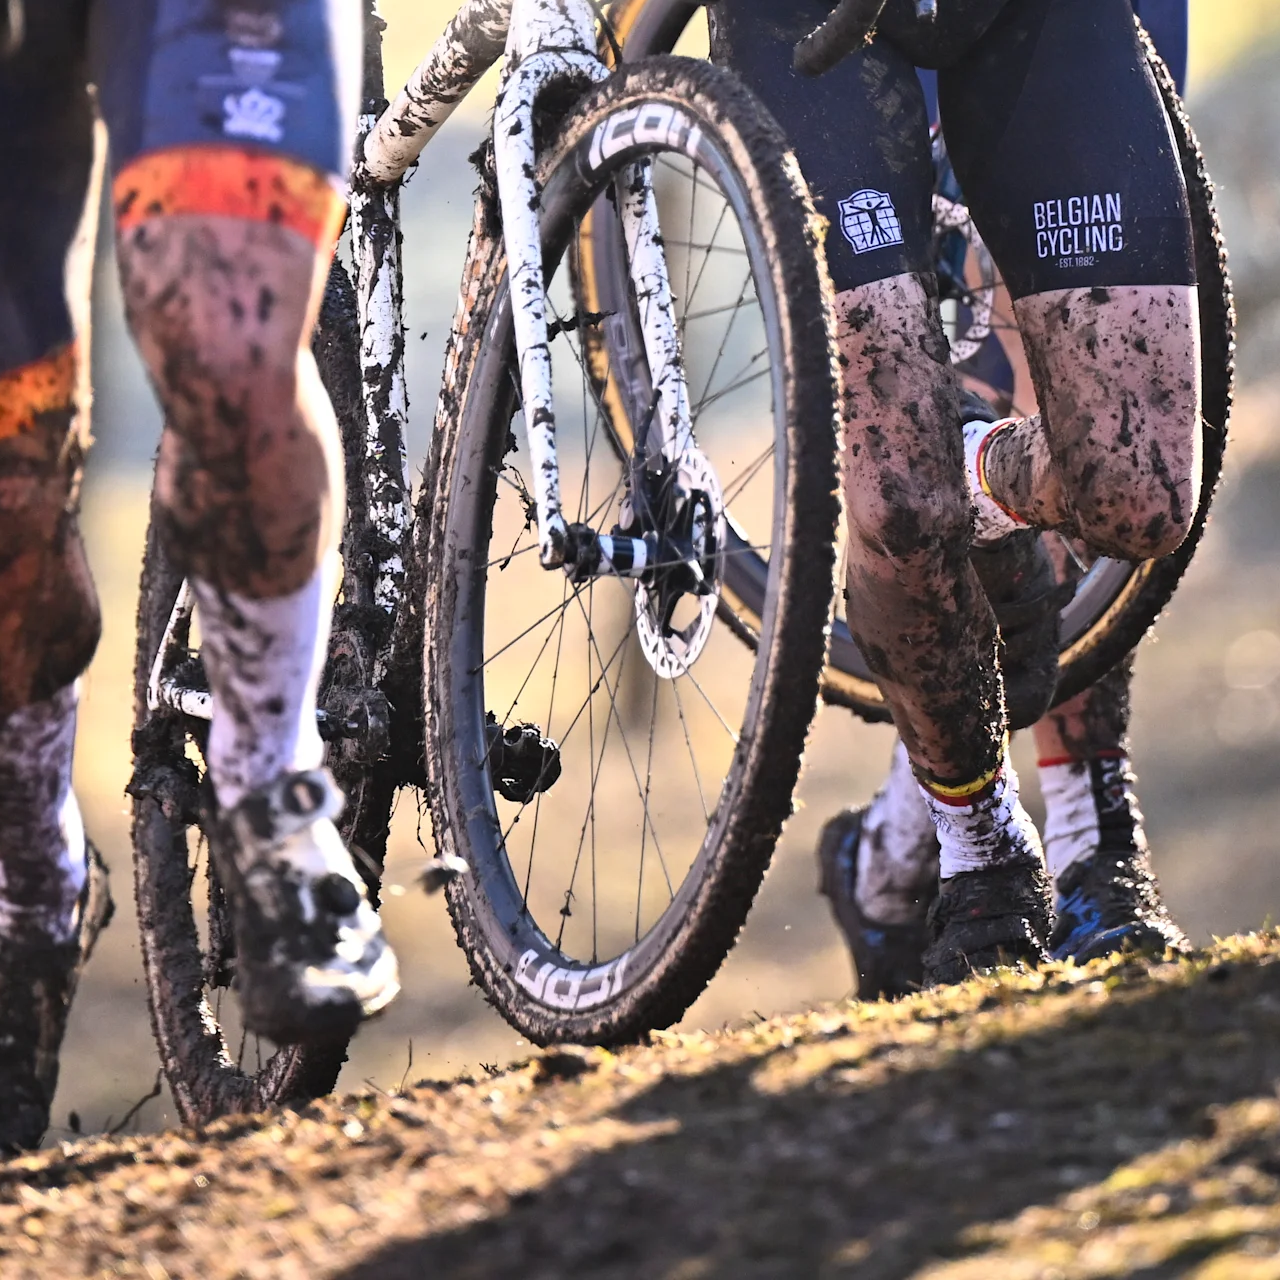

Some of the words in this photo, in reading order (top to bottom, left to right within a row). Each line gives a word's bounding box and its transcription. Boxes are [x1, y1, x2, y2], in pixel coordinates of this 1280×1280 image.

[588, 103, 702, 170] ICON
[1033, 192, 1121, 230] BELGIAN
[1036, 223, 1123, 258] CYCLING
[514, 948, 630, 1009] ICON
